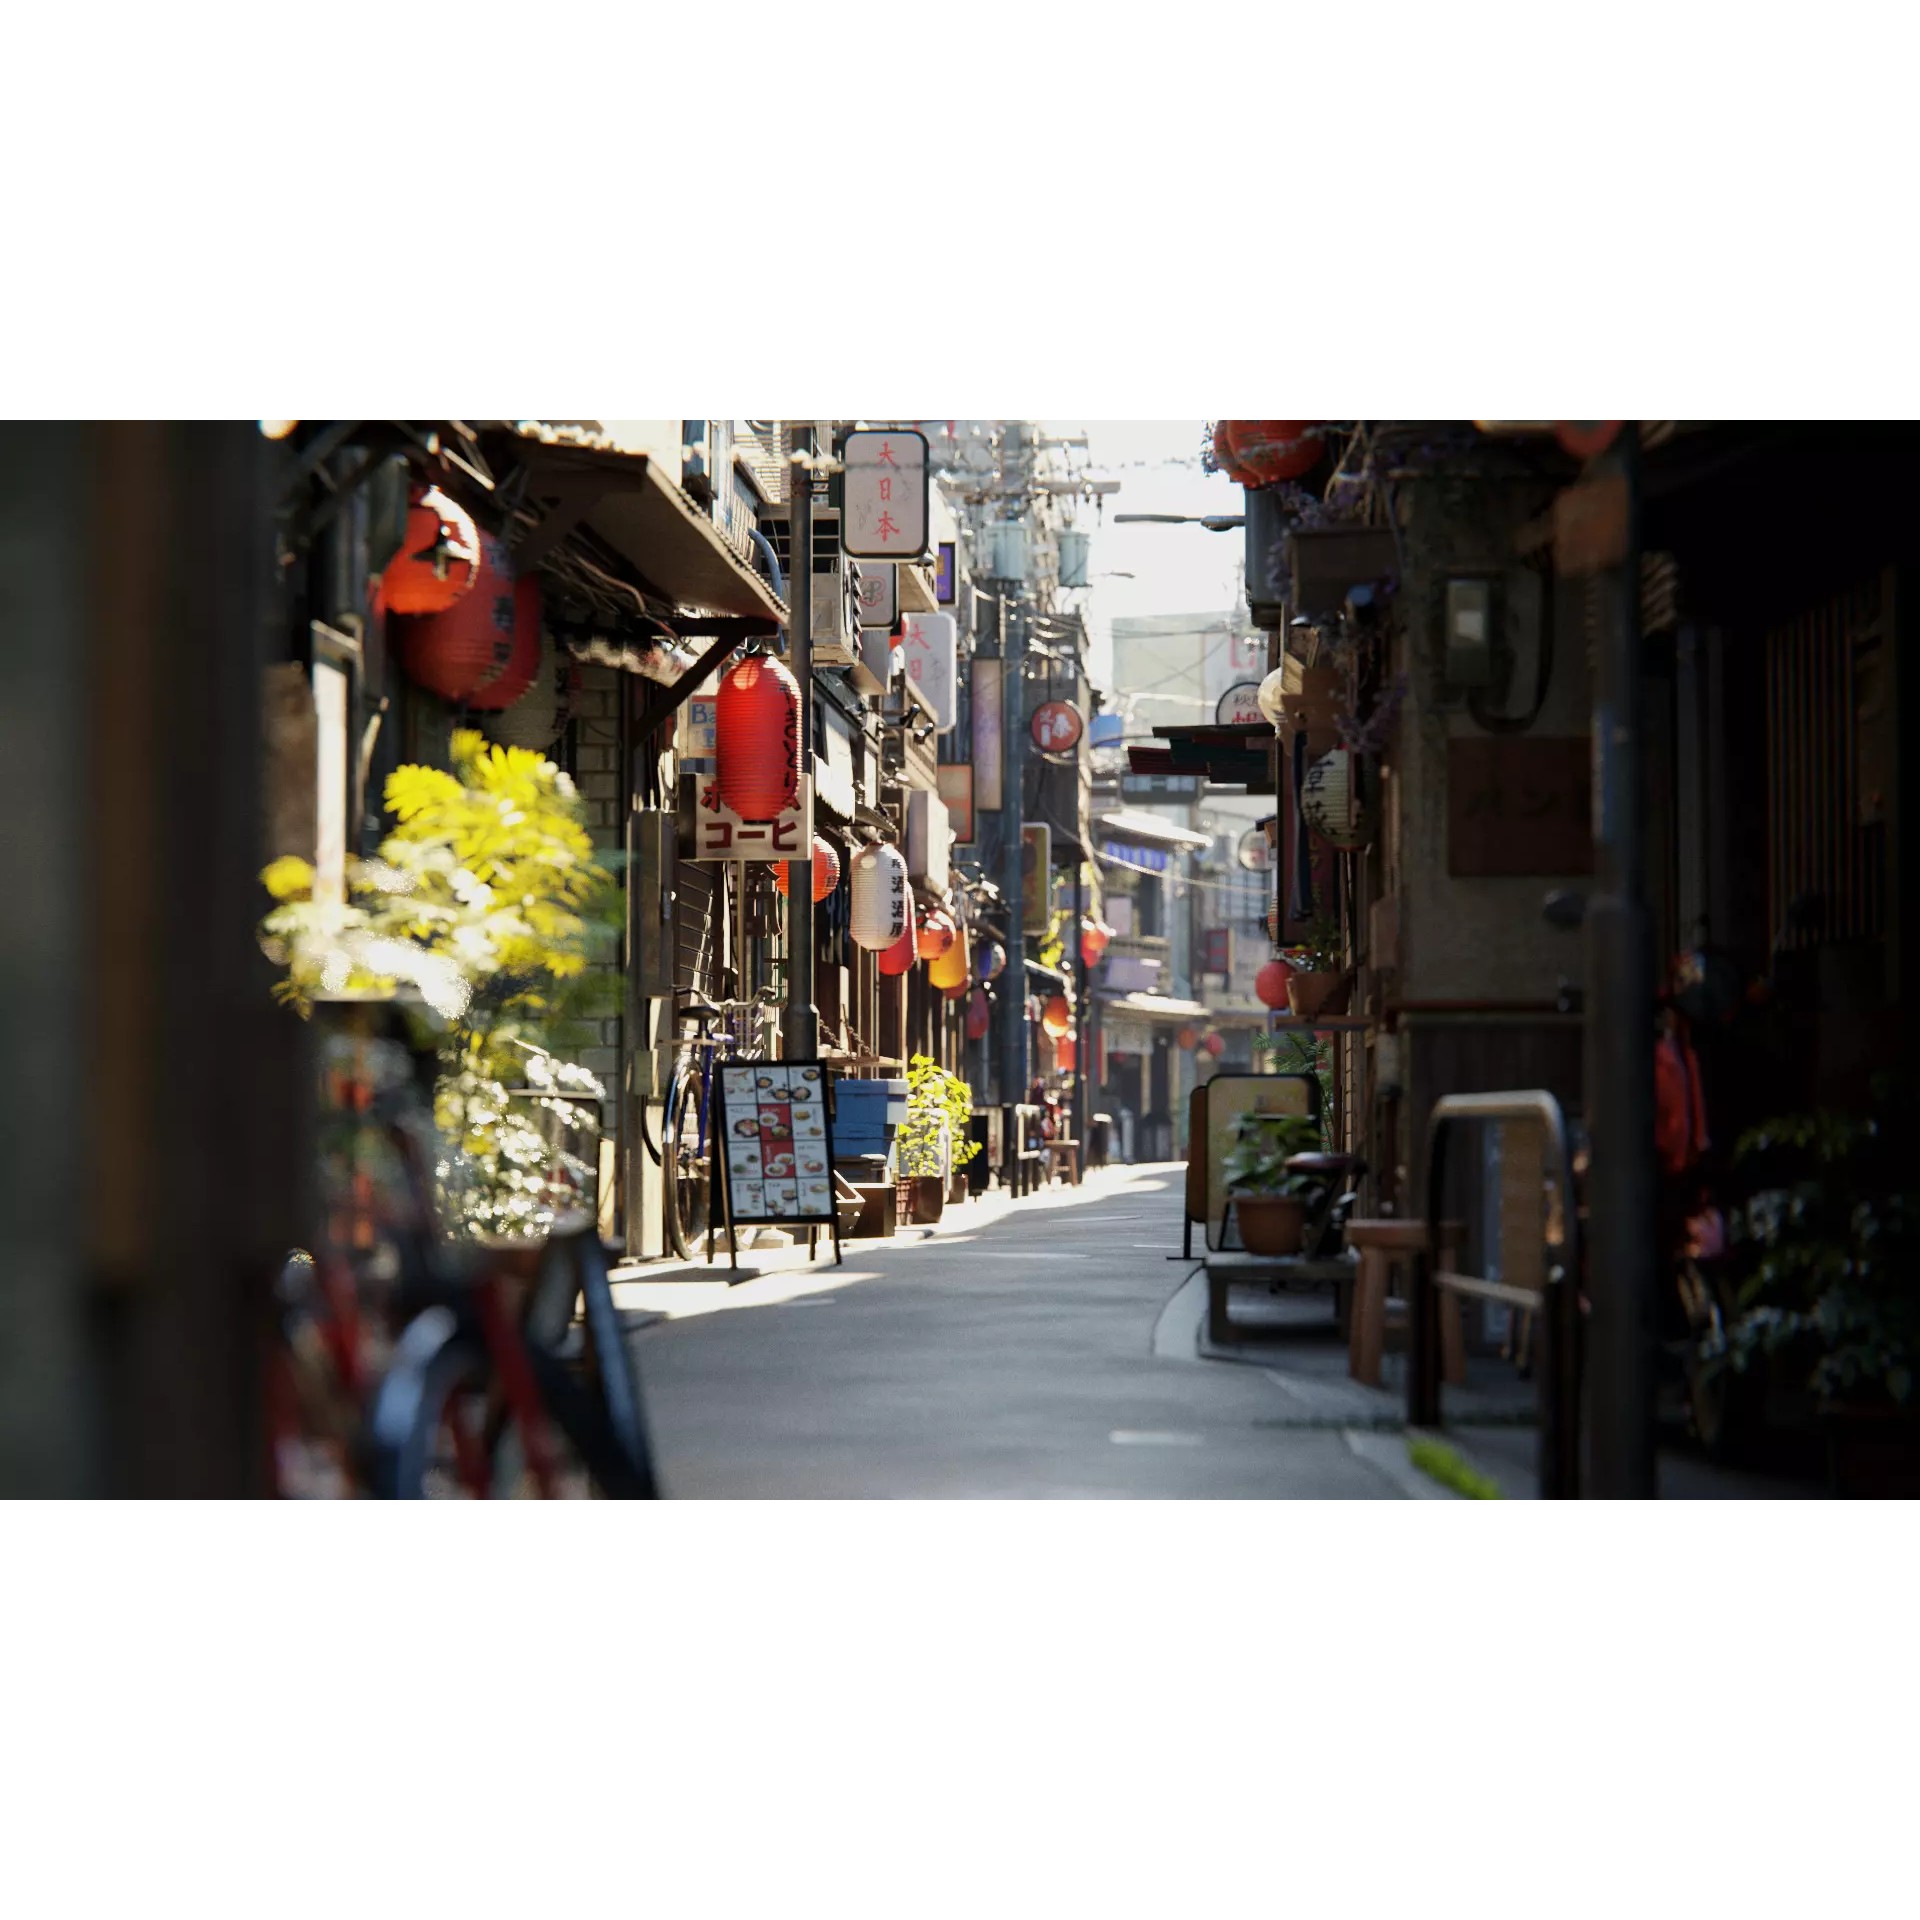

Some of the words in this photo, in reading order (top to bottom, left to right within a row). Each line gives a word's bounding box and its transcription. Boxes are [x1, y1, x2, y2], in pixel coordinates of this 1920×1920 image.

[872, 441, 901, 542] 大日本
[705, 818, 797, 851] コーヒ
